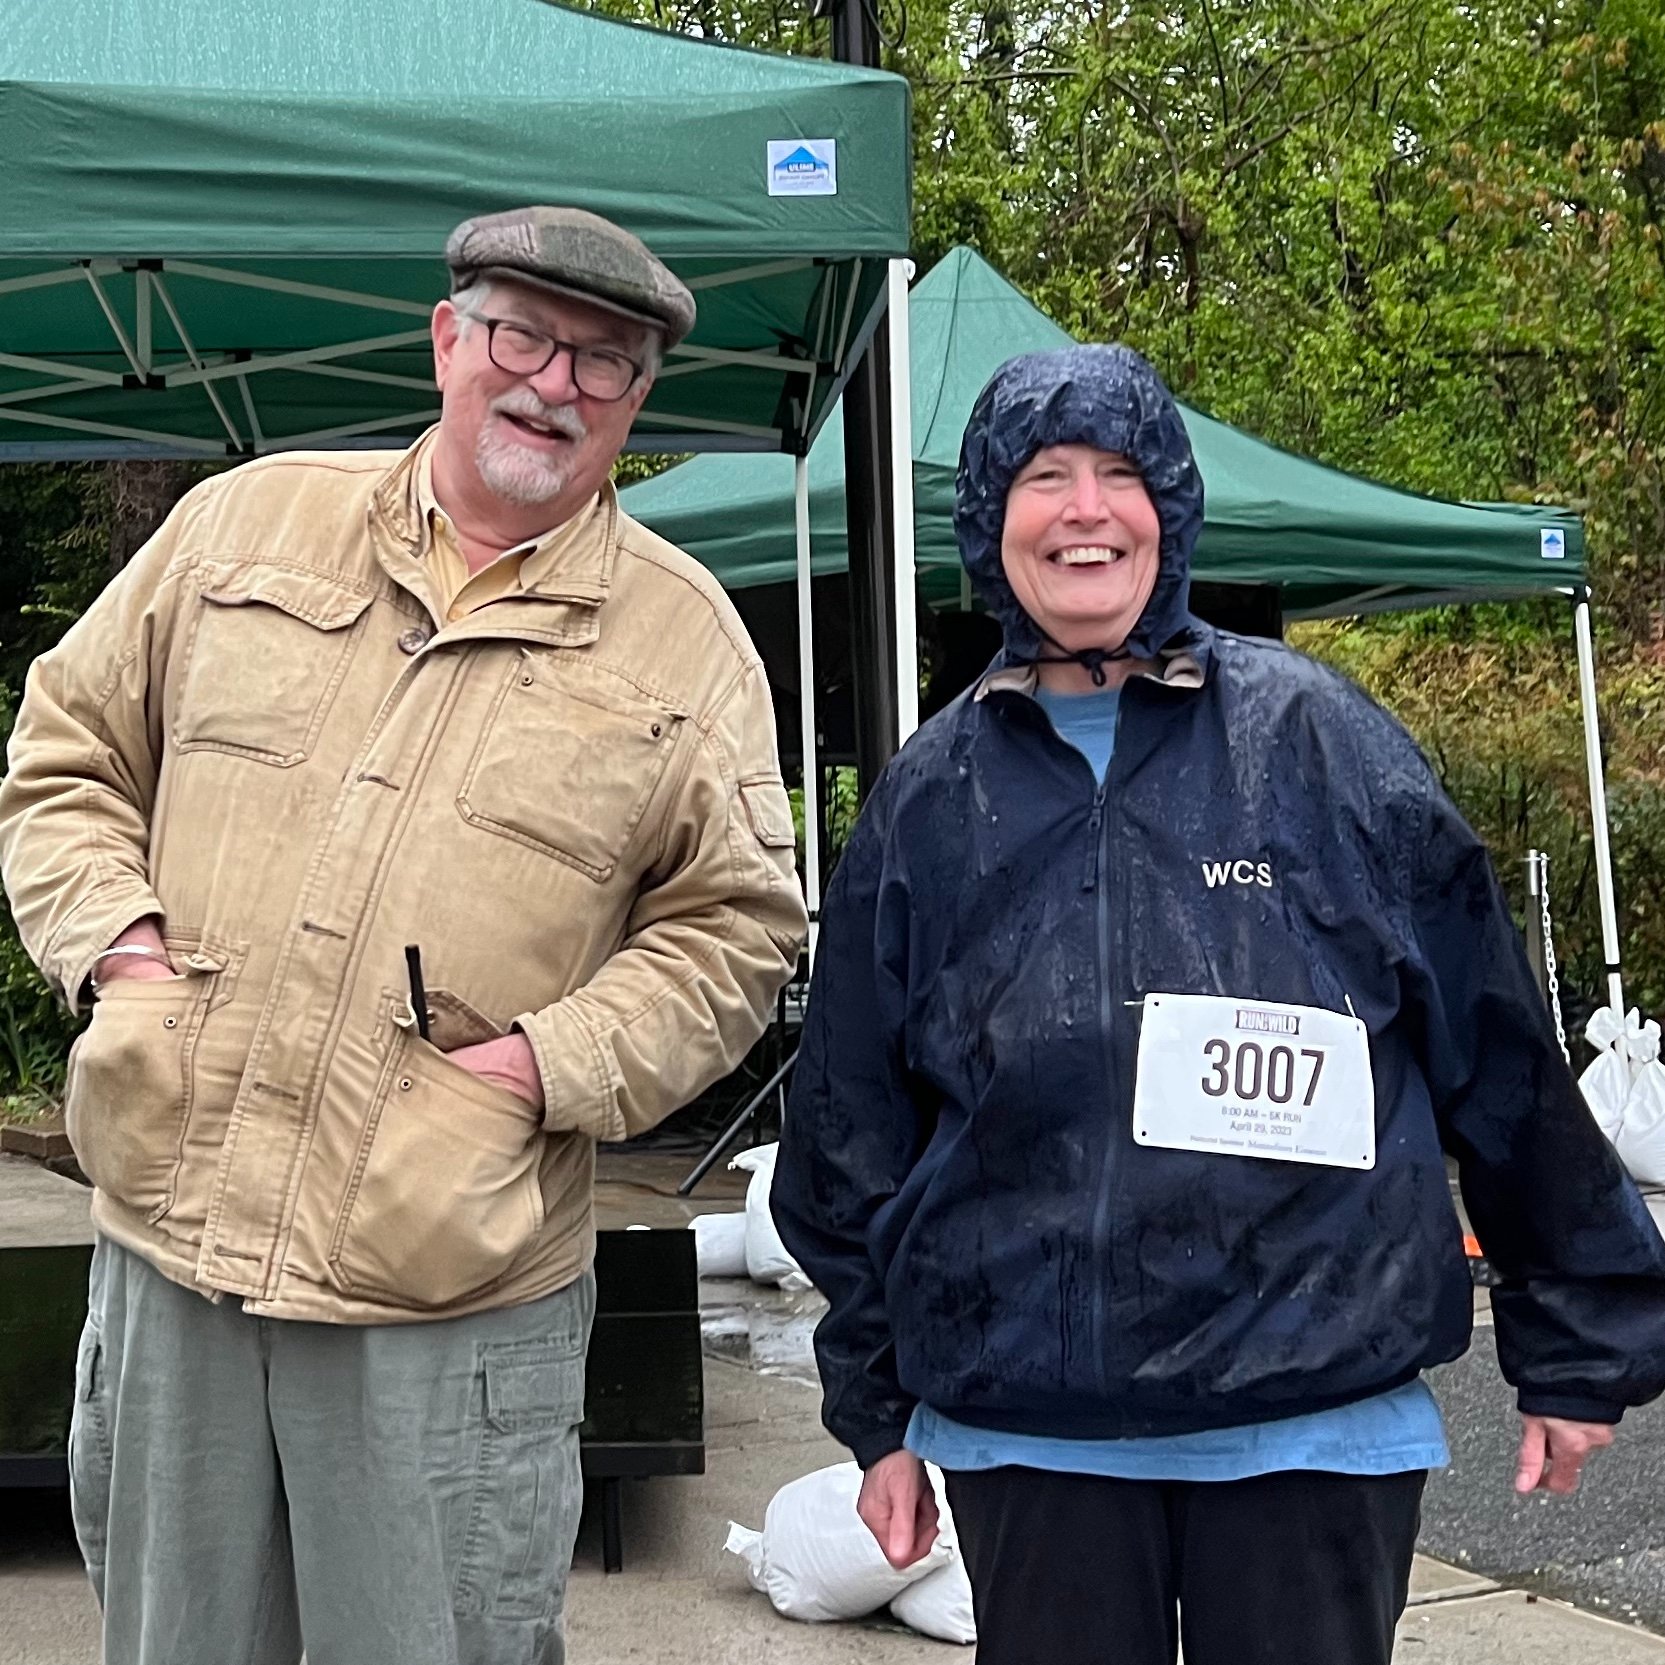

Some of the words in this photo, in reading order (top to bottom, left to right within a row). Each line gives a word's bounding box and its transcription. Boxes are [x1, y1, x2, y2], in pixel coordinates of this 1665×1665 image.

[1202, 859, 1273, 888] WCS
[1239, 1010, 1265, 1031] RUN
[1268, 1013, 1297, 1034] WILD
[1201, 1038, 1325, 1106] 3007
[1229, 1120, 1252, 1132] April
[1243, 1108, 1259, 1119] AM
[1283, 1112, 1302, 1123] RUN
